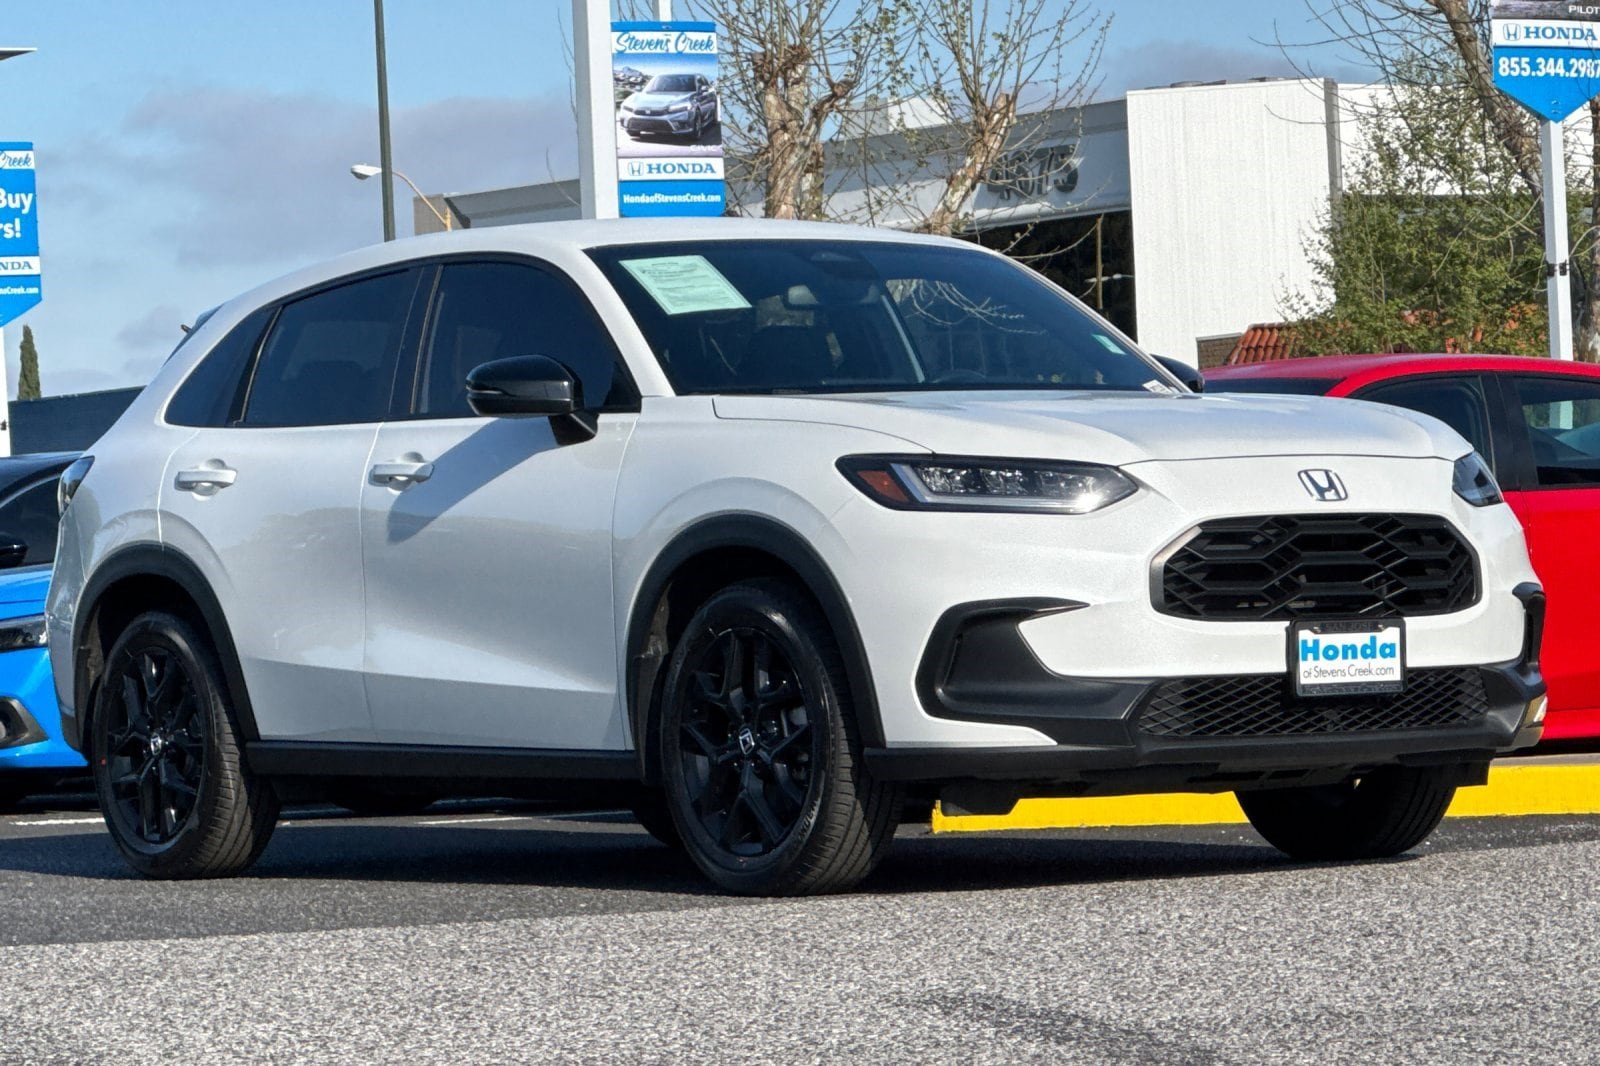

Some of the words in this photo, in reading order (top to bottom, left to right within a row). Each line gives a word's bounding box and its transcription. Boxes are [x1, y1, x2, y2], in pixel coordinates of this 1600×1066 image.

[1568, 5, 1600, 14] PILOT
[1524, 26, 1598, 41] HONDA
[616, 32, 671, 54] Stevens
[674, 32, 715, 54] Creek
[1499, 57, 1600, 78] 855.344.2987
[689, 144, 718, 152] CIVIC
[647, 163, 717, 174] HONDA
[623, 193, 721, 203] HondaofStevensCreek.com
[1301, 635, 1396, 661] Honda
[1303, 667, 1313, 679] of
[1313, 665, 1347, 678] Stevens
[1347, 662, 1395, 677] Creek.com
